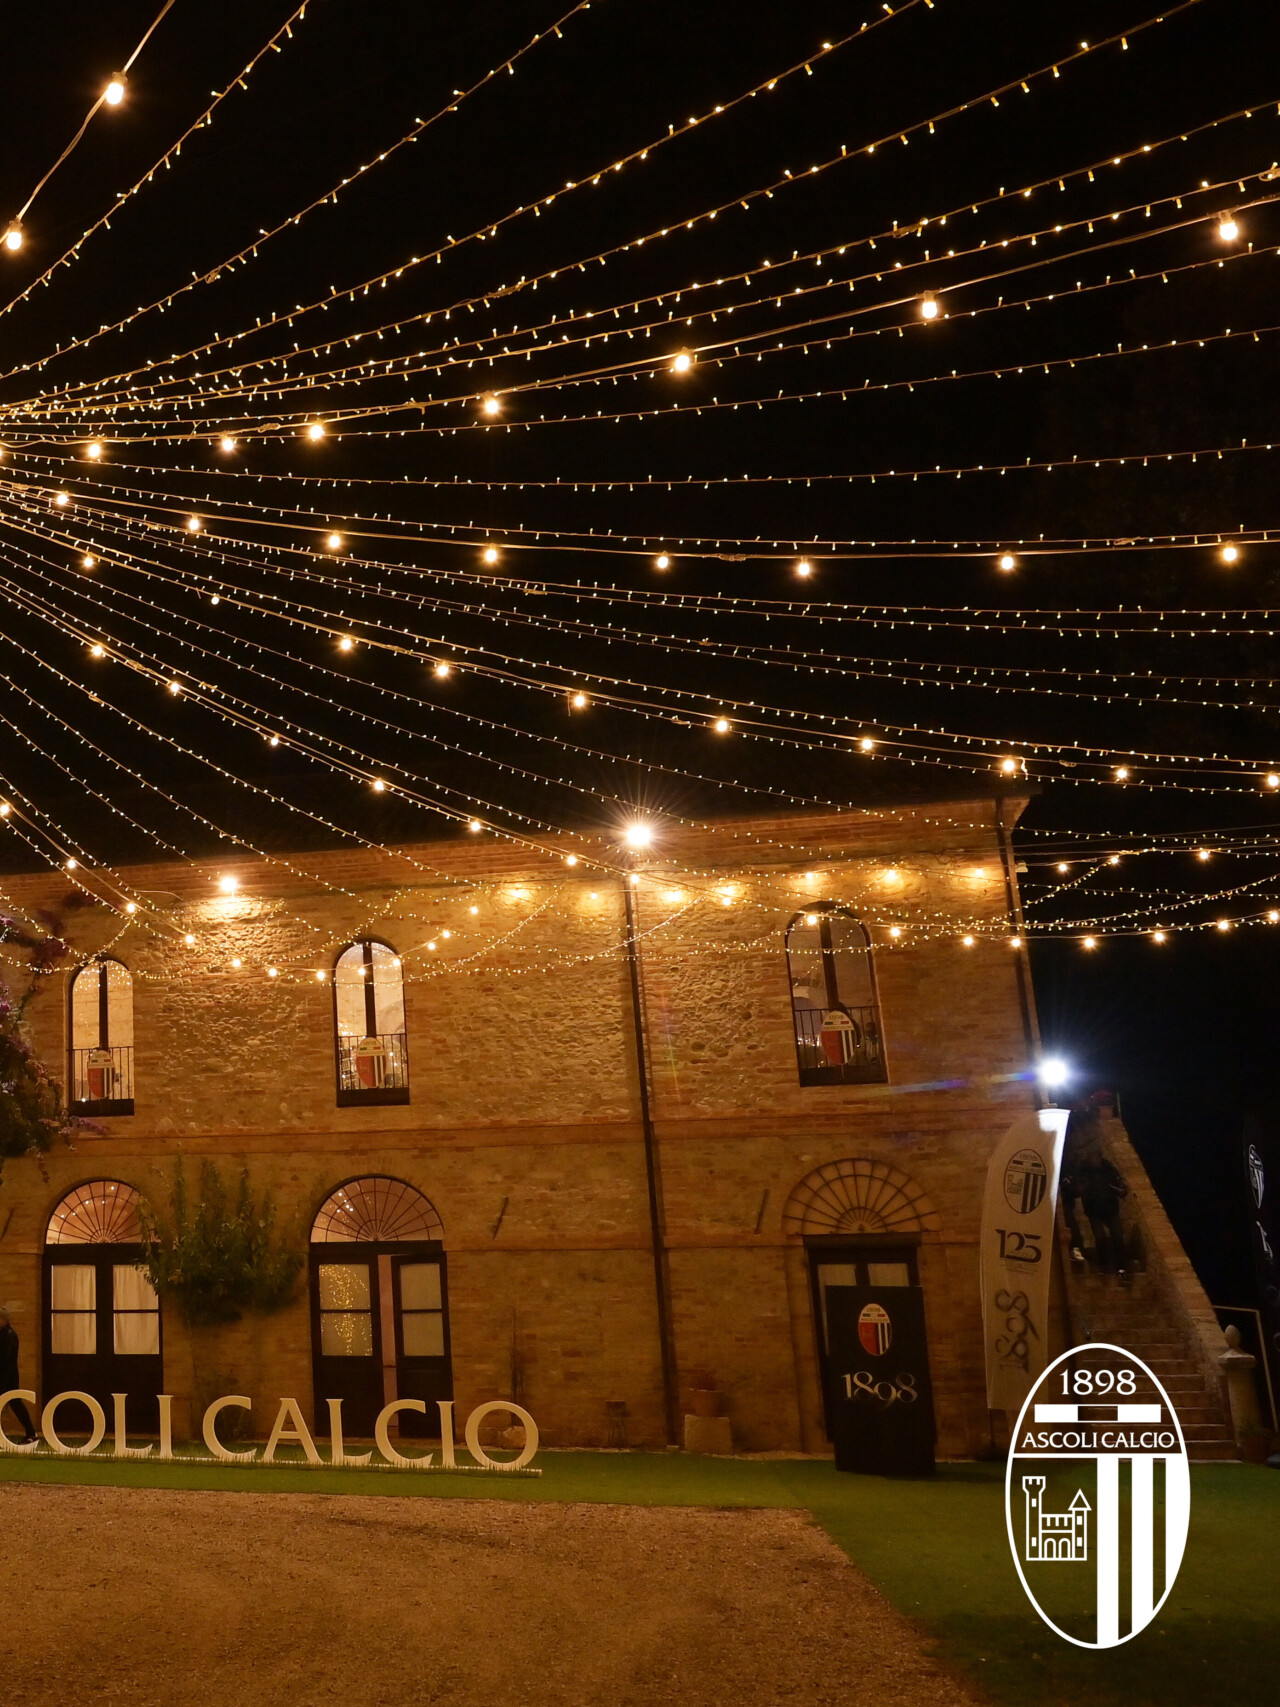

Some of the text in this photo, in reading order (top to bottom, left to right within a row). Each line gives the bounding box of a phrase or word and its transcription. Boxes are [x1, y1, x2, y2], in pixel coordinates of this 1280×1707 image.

[995, 1229, 1042, 1263] 125
[841, 1370, 919, 1411] 1898
[203, 1395, 539, 1468] CALCIO
